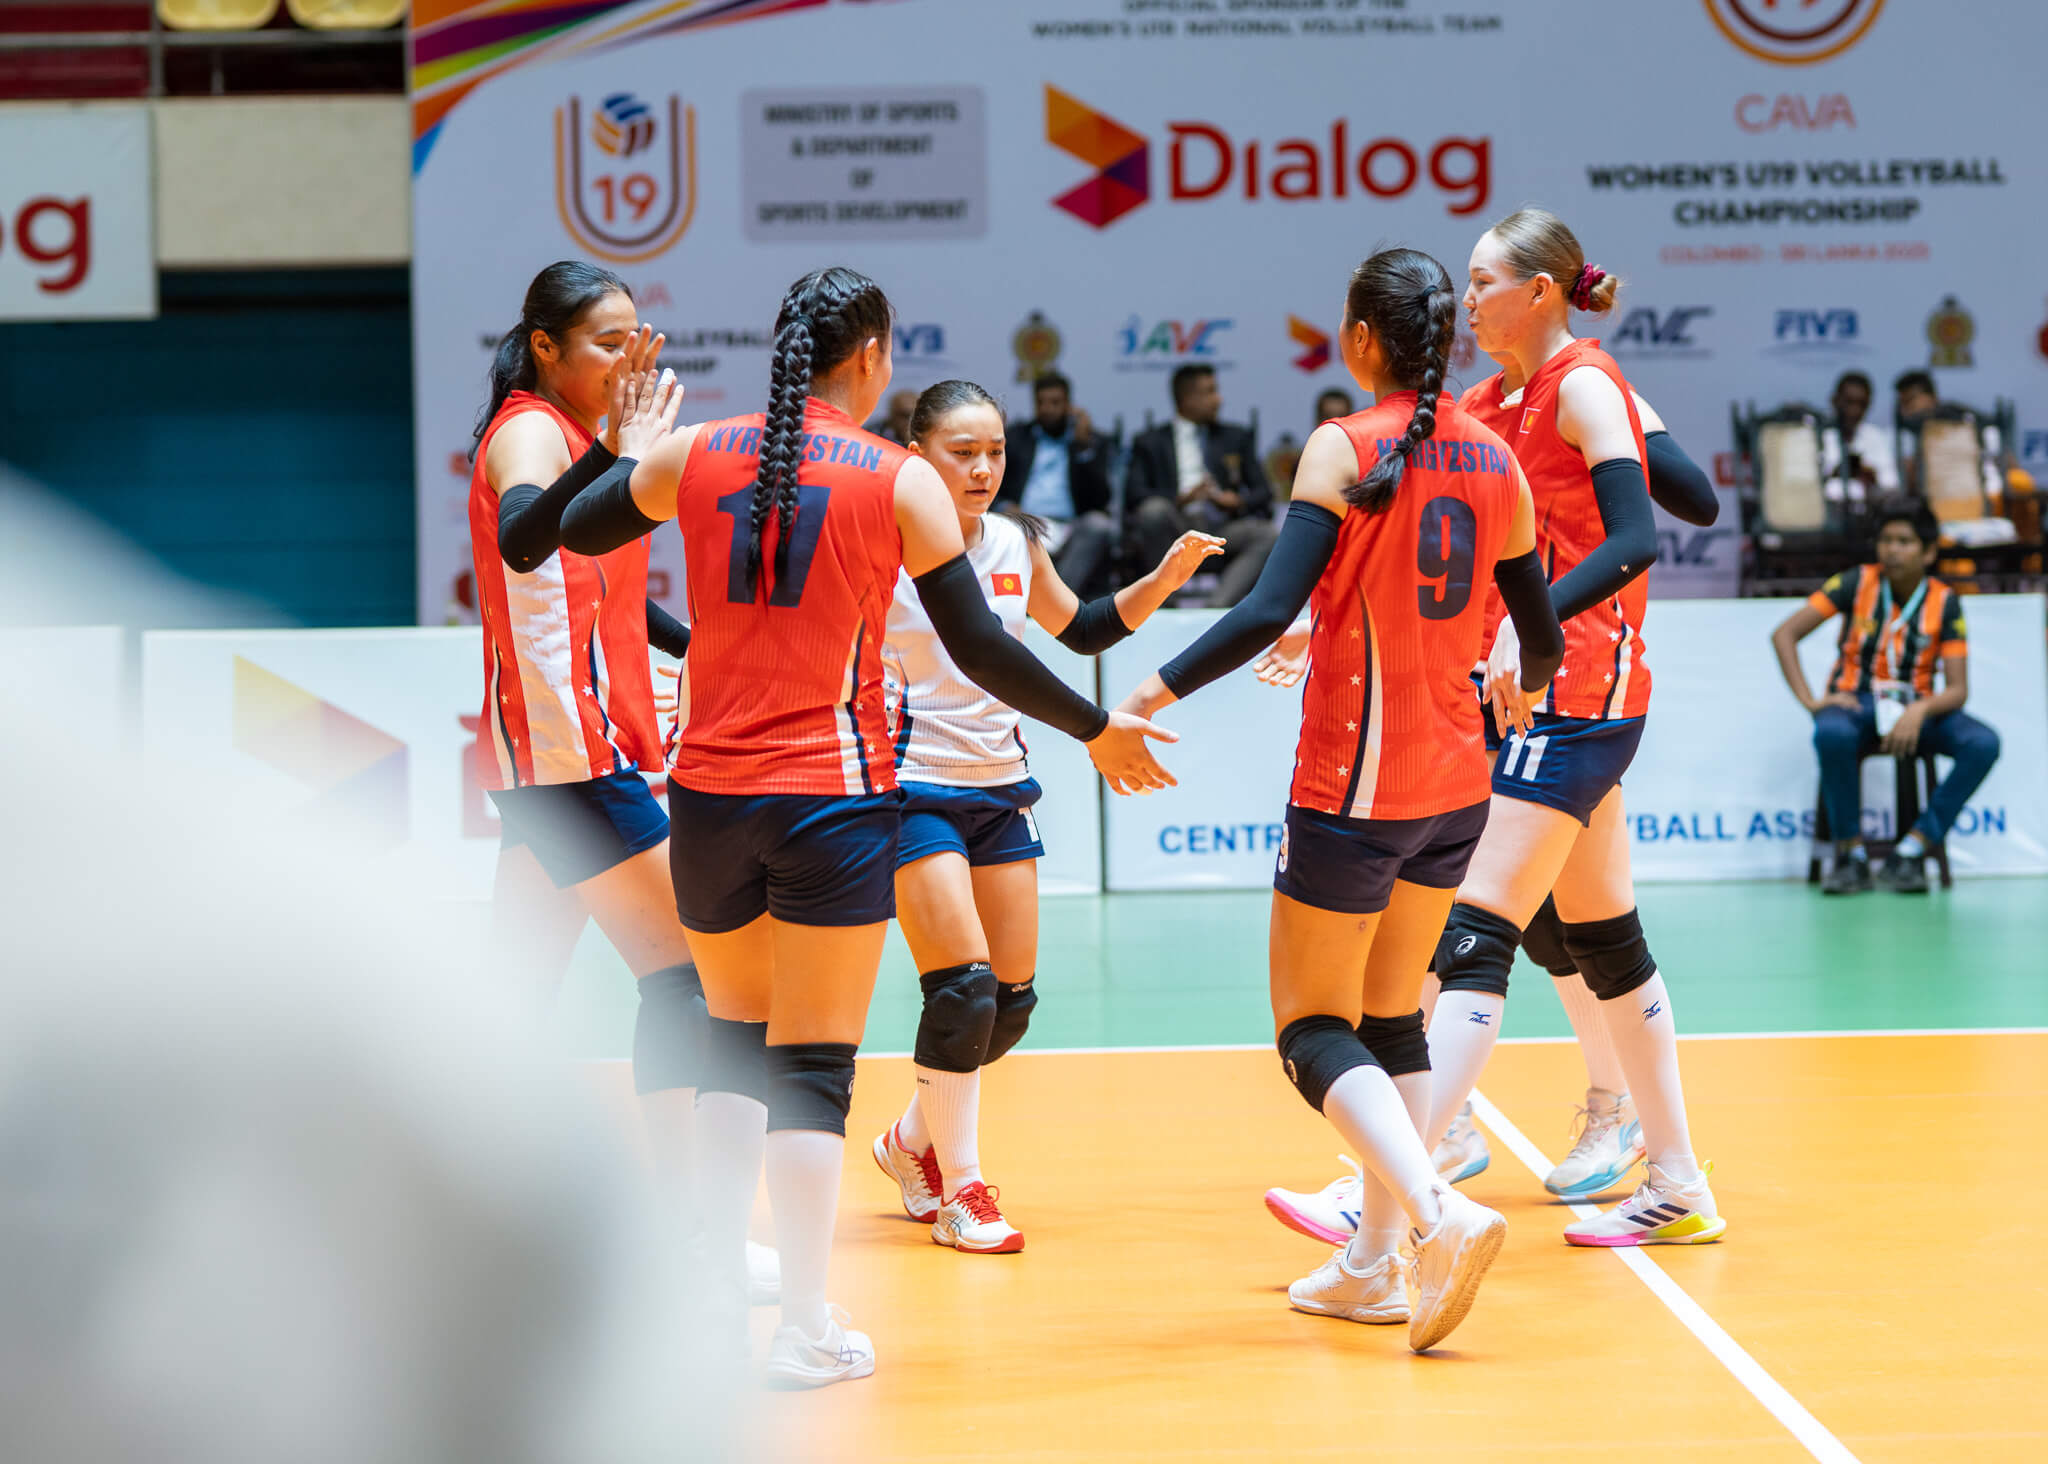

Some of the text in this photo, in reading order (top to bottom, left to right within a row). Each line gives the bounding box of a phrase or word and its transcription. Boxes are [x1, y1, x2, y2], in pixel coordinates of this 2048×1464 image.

[886, 102, 959, 123] SPORTS
[1734, 93, 1857, 134] CAVA
[811, 134, 934, 156] DEPARTMENT
[1166, 117, 1492, 218] Dialog
[1587, 157, 2006, 190] WOMEN'S U19 VOLLEYBALL
[592, 173, 659, 224] 19
[758, 199, 969, 225] SPORTS DEVELOPMENT
[1673, 197, 1922, 228] CHAMPIONSHIP
[1774, 309, 1859, 341] FIVB
[716, 480, 832, 608] 17
[1417, 496, 1477, 620] 9
[1503, 731, 1550, 782] 11
[1158, 823, 1285, 855] CENTR
